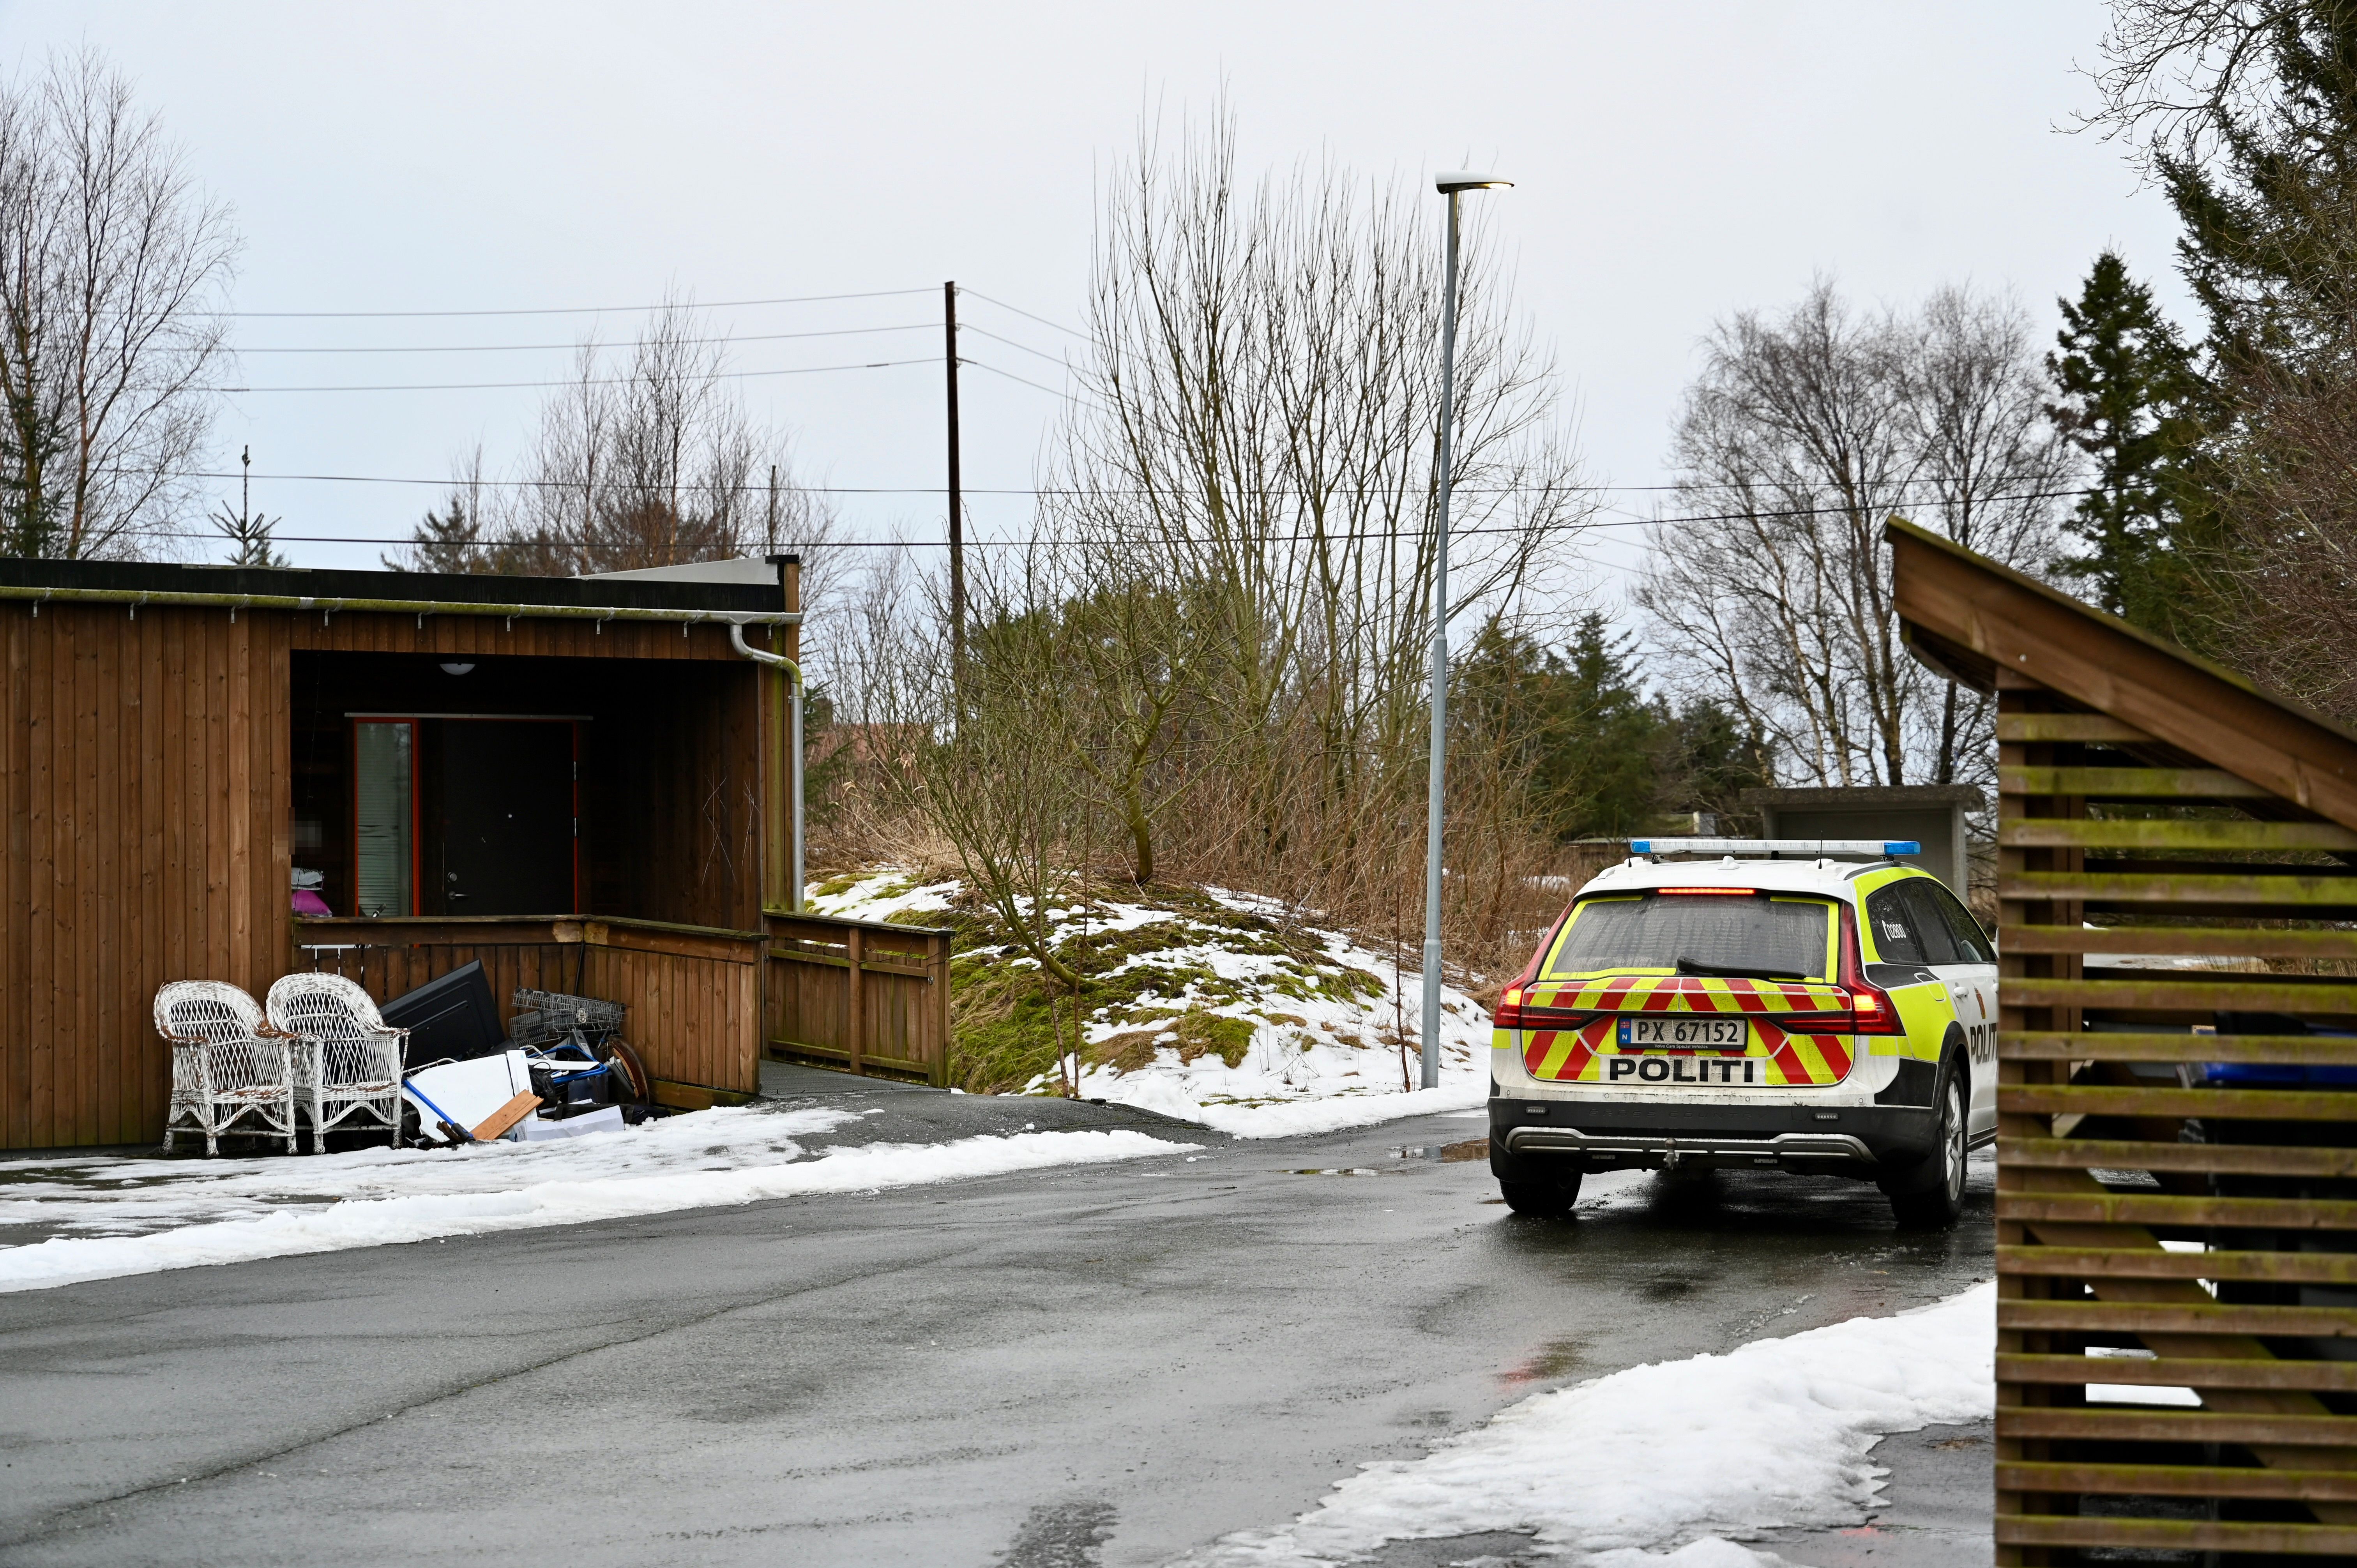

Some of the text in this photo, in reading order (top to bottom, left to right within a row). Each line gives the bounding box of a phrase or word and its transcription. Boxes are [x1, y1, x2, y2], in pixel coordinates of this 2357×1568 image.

[1886, 923, 1906, 938] 02800
[1638, 1021, 1738, 1043] PX 67152
[1610, 1059, 1753, 1082] POLITI
